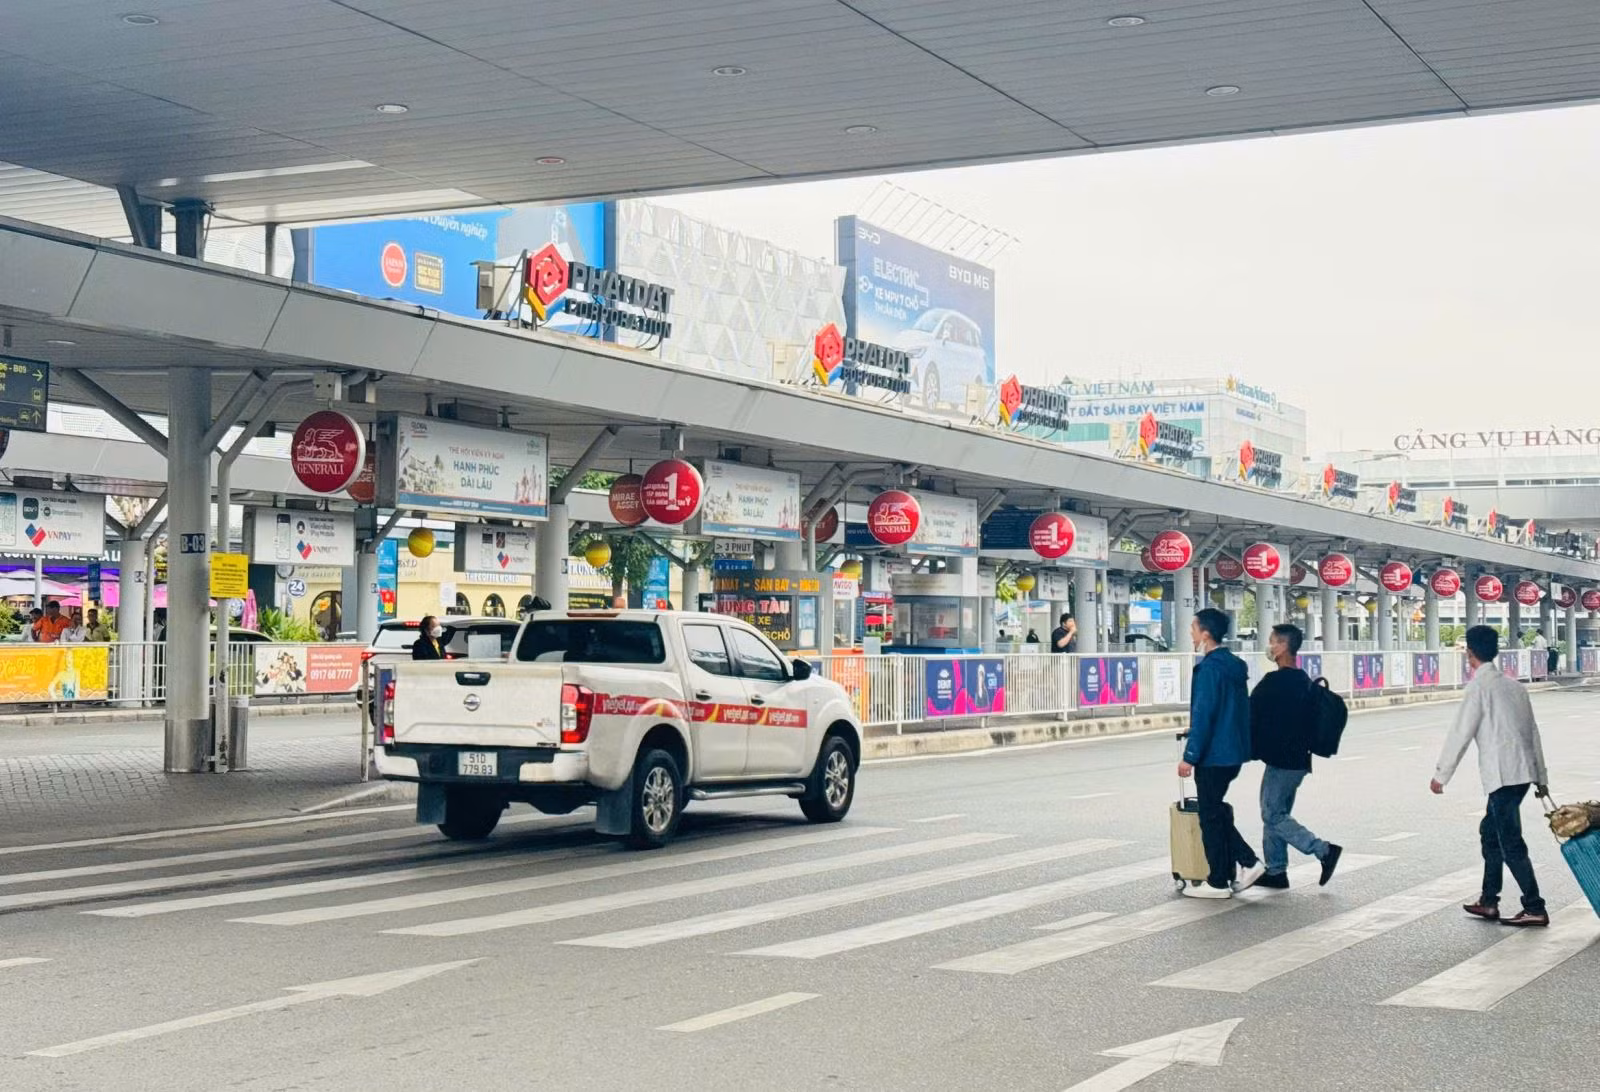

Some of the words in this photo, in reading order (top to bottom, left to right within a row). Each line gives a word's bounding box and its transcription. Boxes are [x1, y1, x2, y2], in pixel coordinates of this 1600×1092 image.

[873, 257, 919, 287] ELECTRIC
[949, 265, 971, 283] BYD
[973, 272, 990, 290] M6
[565, 298, 672, 338] CORPORATION
[1394, 428, 1467, 450] CẢNG
[1477, 431, 1513, 451] VỤ
[297, 463, 345, 475] GENERALI
[664, 472, 681, 511] 1
[875, 524, 912, 534] GENERALI
[182, 535, 205, 552] B-03
[760, 597, 790, 614] TÀU
[758, 616, 772, 625] XE
[469, 753, 486, 763] 51D
[463, 764, 493, 775] 779.83
